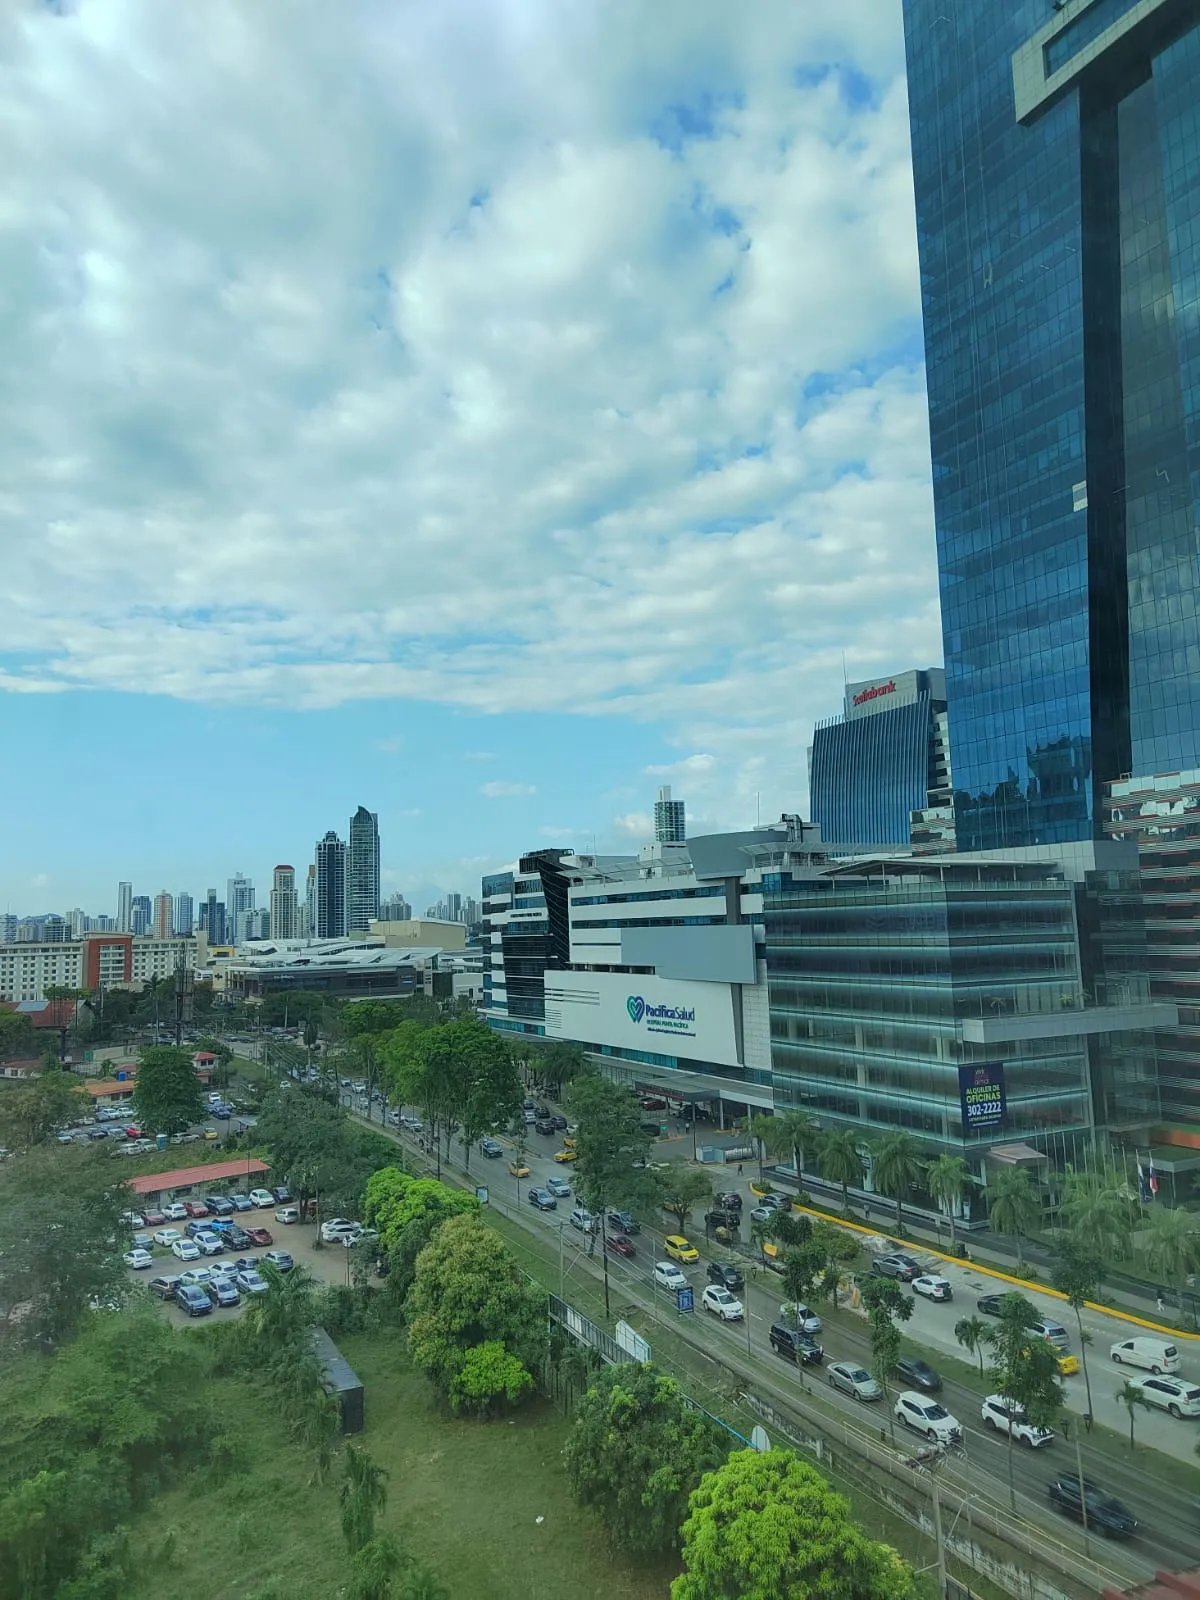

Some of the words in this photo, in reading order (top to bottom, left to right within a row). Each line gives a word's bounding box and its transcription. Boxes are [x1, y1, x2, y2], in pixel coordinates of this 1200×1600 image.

[966, 1085, 992, 1095] ALQUILER
[966, 1092, 1001, 1104] OFICINAS
[967, 1101, 1002, 1117] 302-2222
